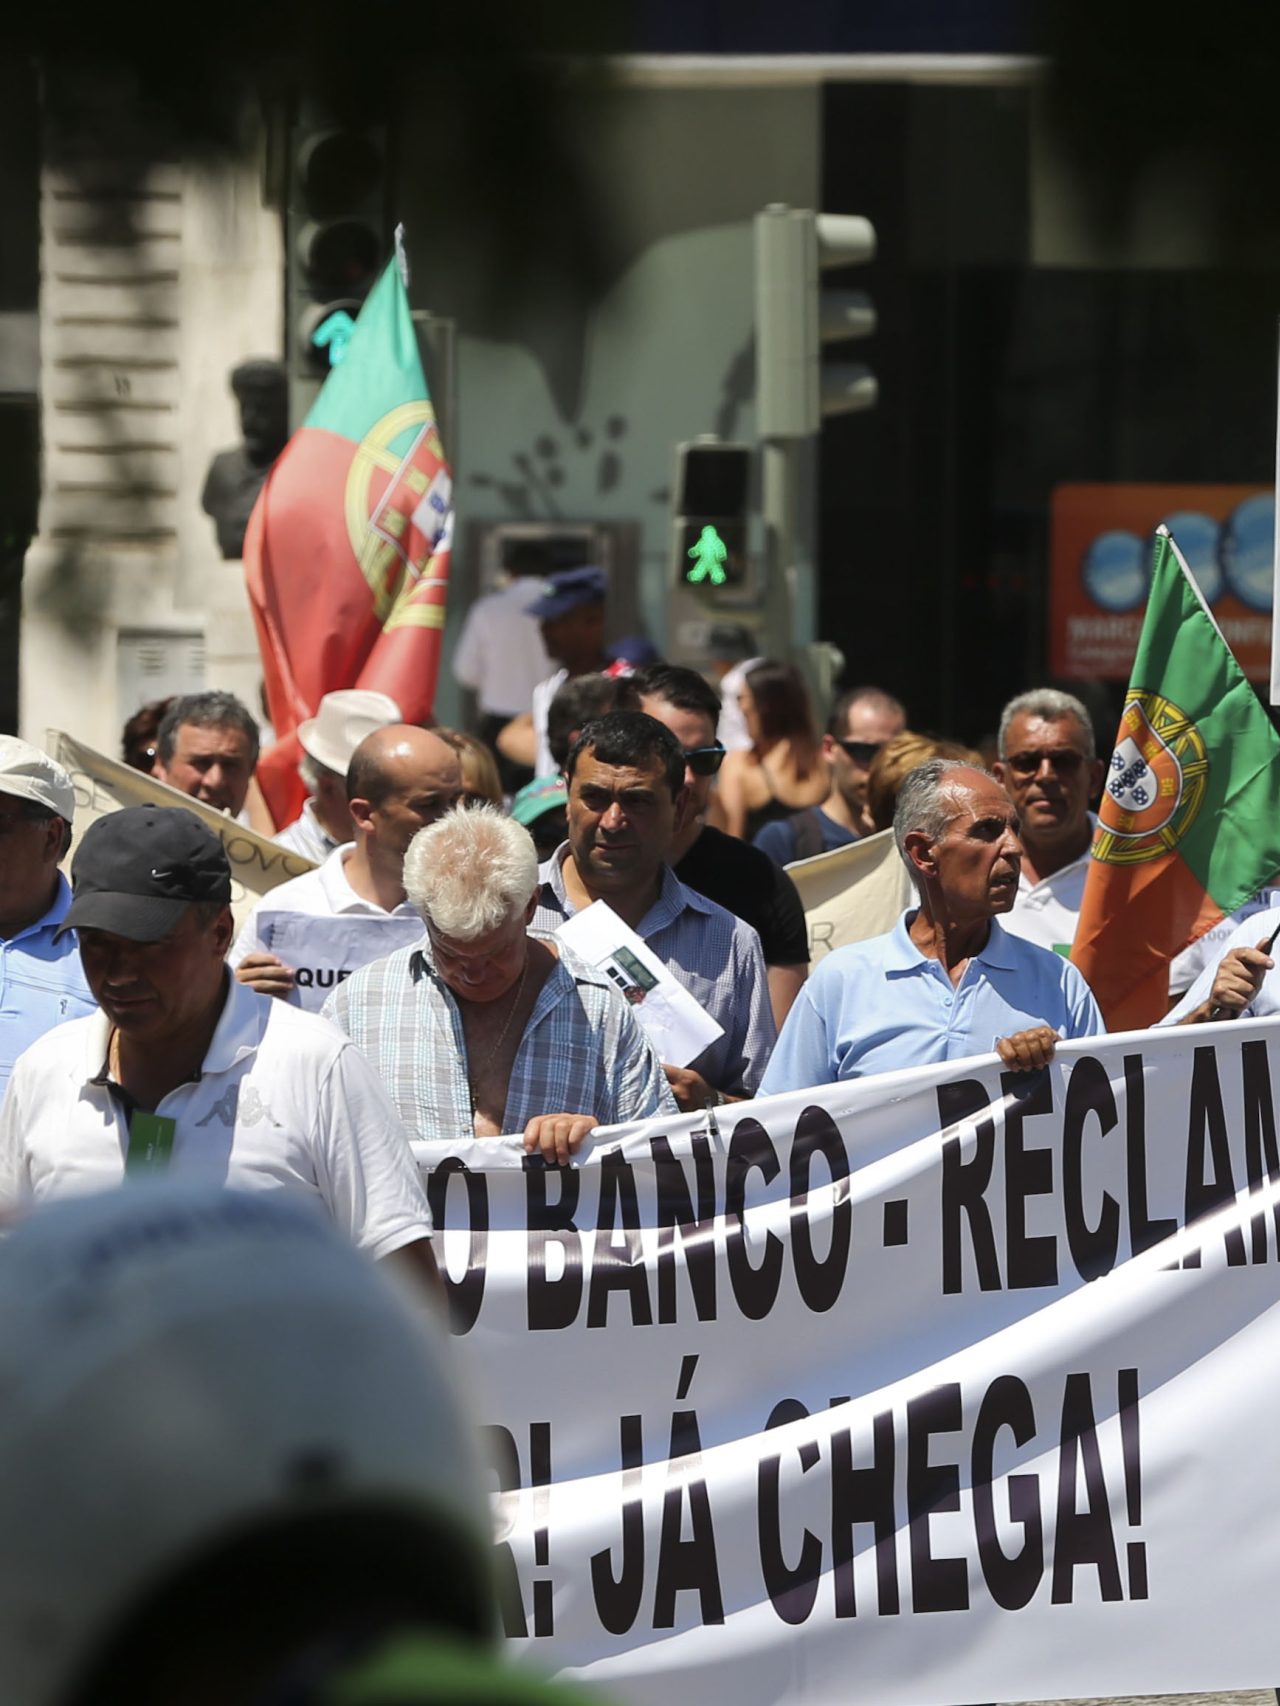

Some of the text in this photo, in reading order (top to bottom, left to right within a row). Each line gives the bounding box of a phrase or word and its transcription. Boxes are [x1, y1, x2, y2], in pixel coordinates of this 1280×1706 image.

[521, 1105, 851, 1332] BANCO
[590, 1354, 726, 1635] JÁ
[757, 1367, 1149, 1626] CHEGA!
